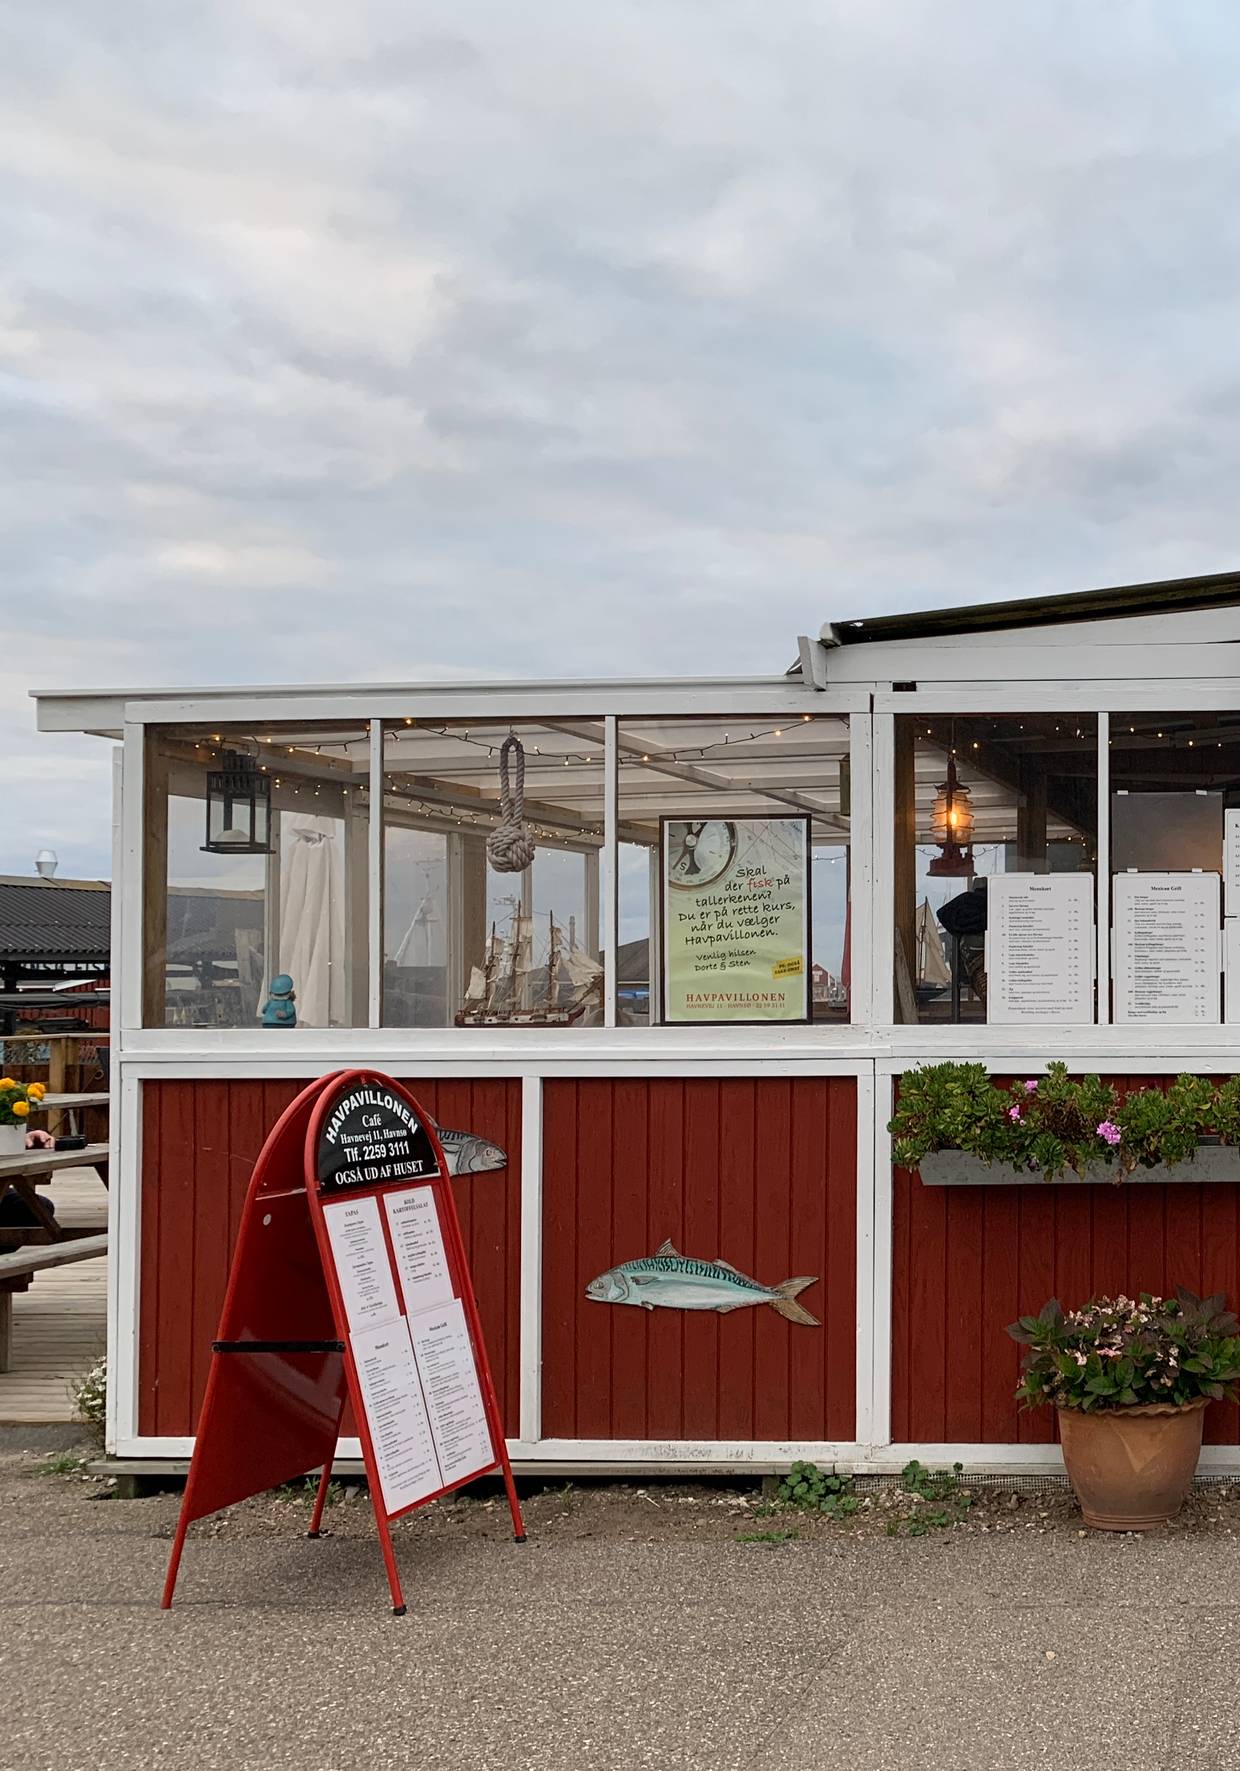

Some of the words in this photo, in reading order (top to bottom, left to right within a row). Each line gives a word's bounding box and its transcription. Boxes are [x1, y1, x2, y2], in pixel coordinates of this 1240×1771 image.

[725, 881, 744, 891] der
[747, 878, 774, 892] fisk
[776, 874, 790, 890] på
[696, 890, 772, 907] tallerkenen?
[678, 913, 696, 921] Du
[700, 911, 711, 920] er
[714, 906, 728, 921] på
[732, 905, 759, 916] rette
[762, 902, 795, 913] kurs,
[691, 921, 713, 933] når
[717, 920, 733, 930] du
[737, 915, 781, 928] vælger
[685, 929, 778, 947] Havpavillonen.
[728, 949, 757, 958] hilsen
[695, 963, 717, 972] Dorte
[686, 992, 786, 1002] HAVPAVILLONEN
[326, 1090, 418, 1144] HAVPAVILLONEN
[362, 1113, 382, 1127] Café
[340, 1131, 372, 1144] Havnevej
[373, 1130, 383, 1140] 11,
[344, 1147, 362, 1162] Tlf.
[363, 1144, 387, 1160] 2259
[388, 1141, 410, 1156] 3111
[335, 1166, 363, 1184] OGSÅ
[364, 1167, 378, 1180] UD
[380, 1165, 392, 1178] AF
[393, 1160, 423, 1176] HUSET
